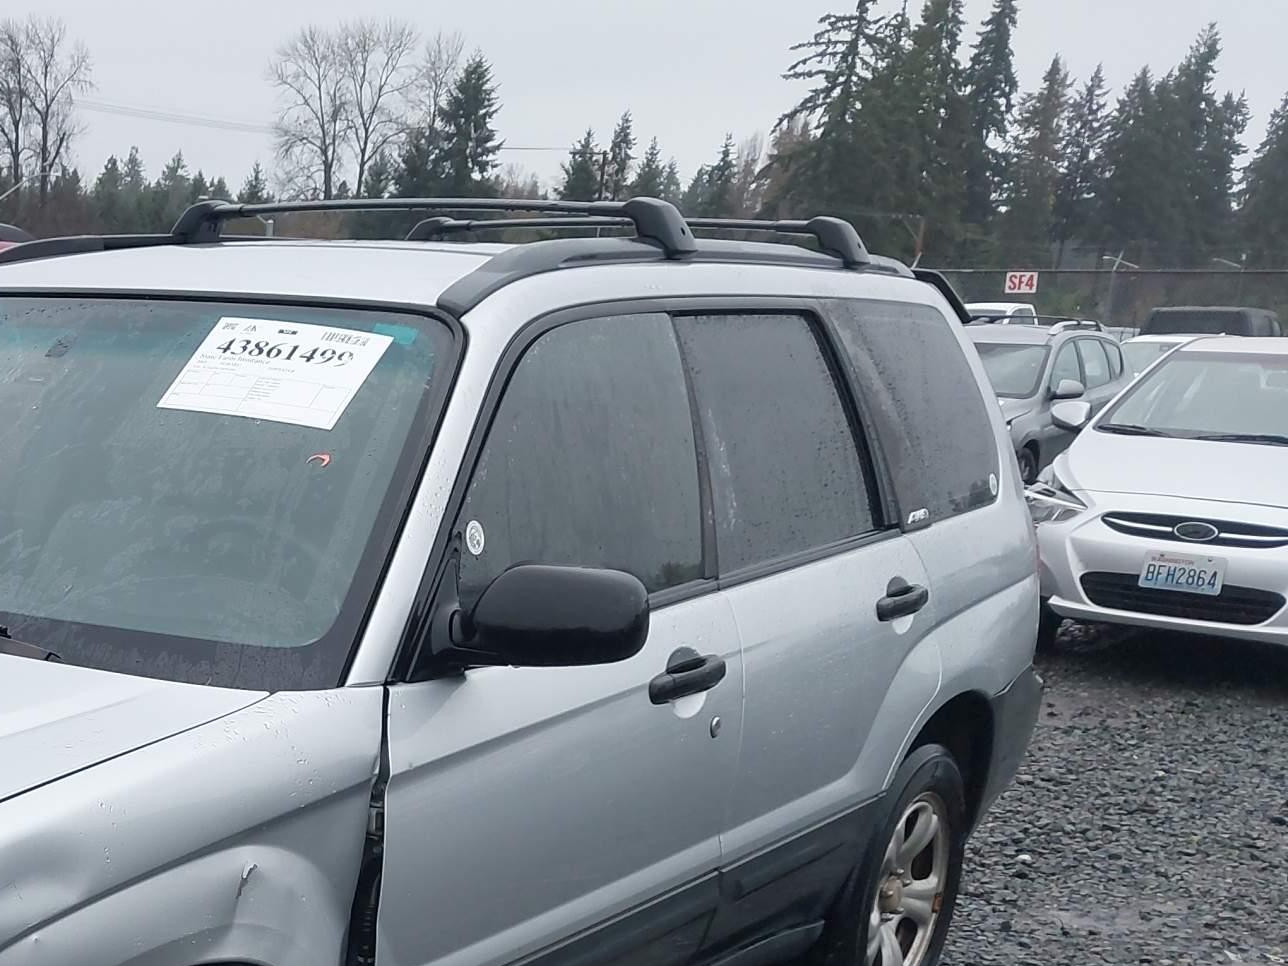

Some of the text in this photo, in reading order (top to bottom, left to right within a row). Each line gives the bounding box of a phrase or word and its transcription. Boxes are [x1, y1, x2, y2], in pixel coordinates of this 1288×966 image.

[1008, 274, 1035, 290] SF4
[216, 337, 354, 368] 43861499
[1144, 563, 1218, 589] BFH2864
